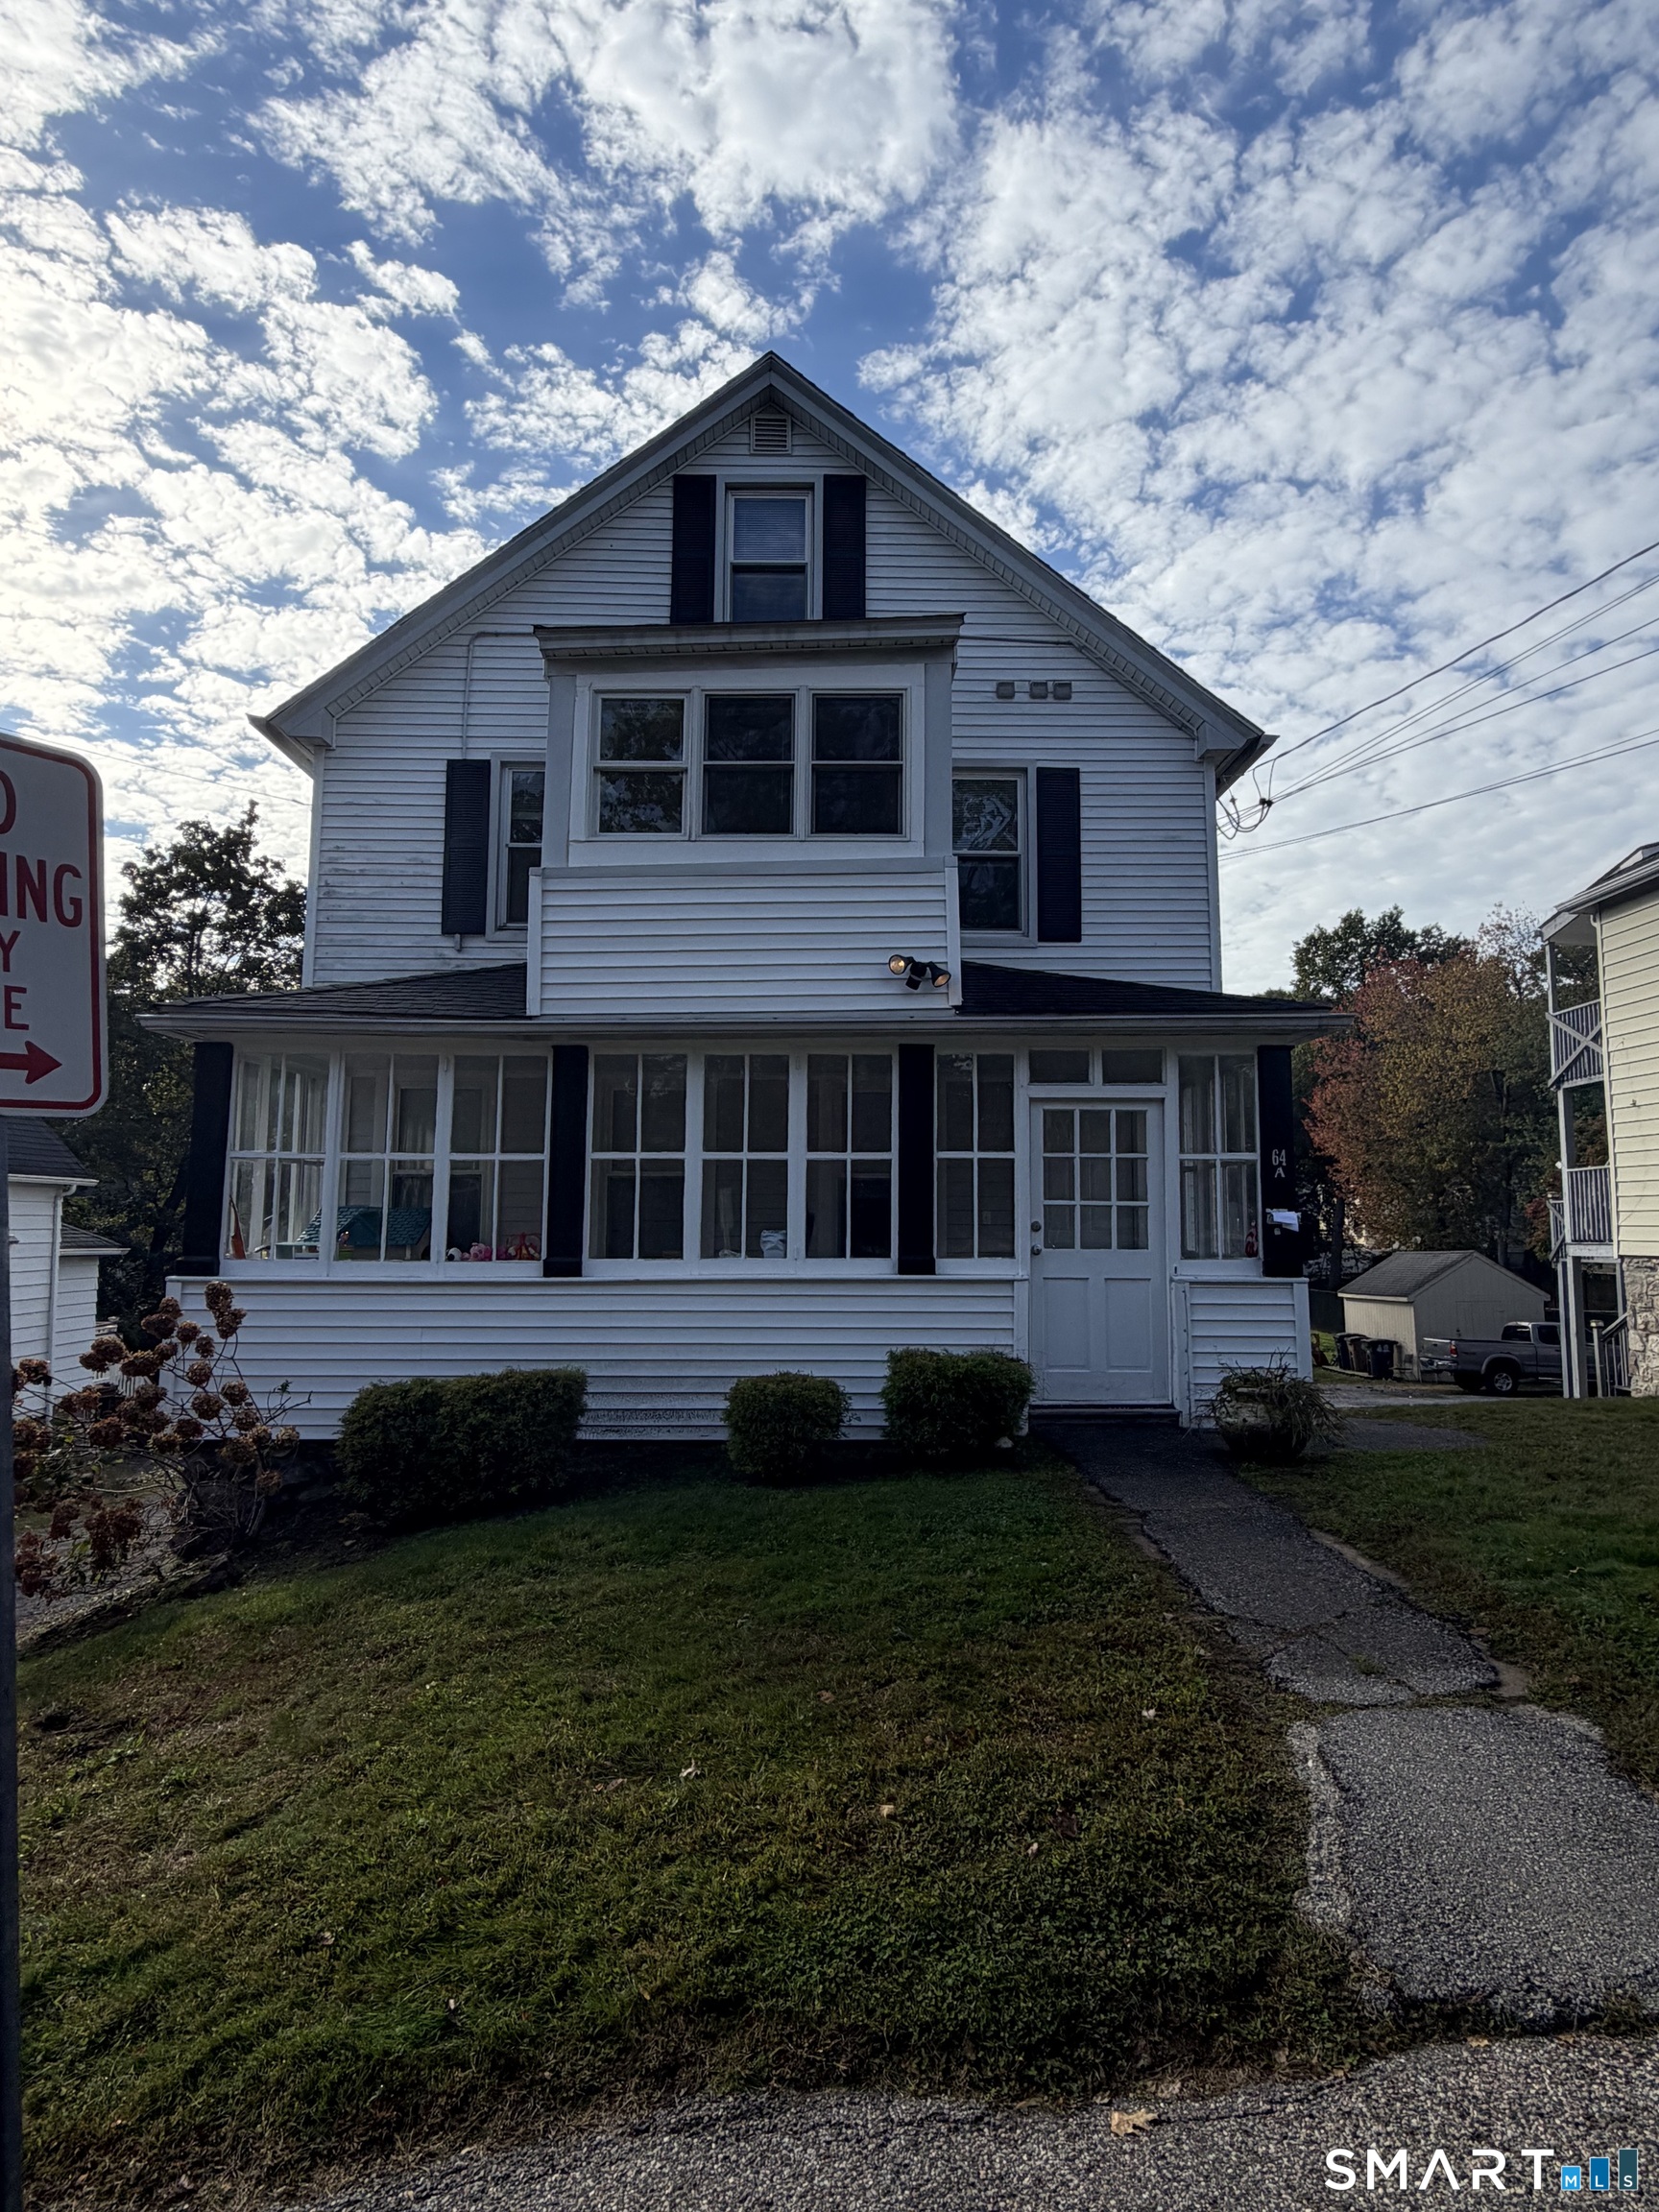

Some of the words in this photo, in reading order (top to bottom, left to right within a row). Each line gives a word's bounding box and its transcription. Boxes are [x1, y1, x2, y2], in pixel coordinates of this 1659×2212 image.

[4, 985, 30, 1030] E
[1272, 1148, 1286, 1166] 64
[1274, 1166, 1286, 1178] A
